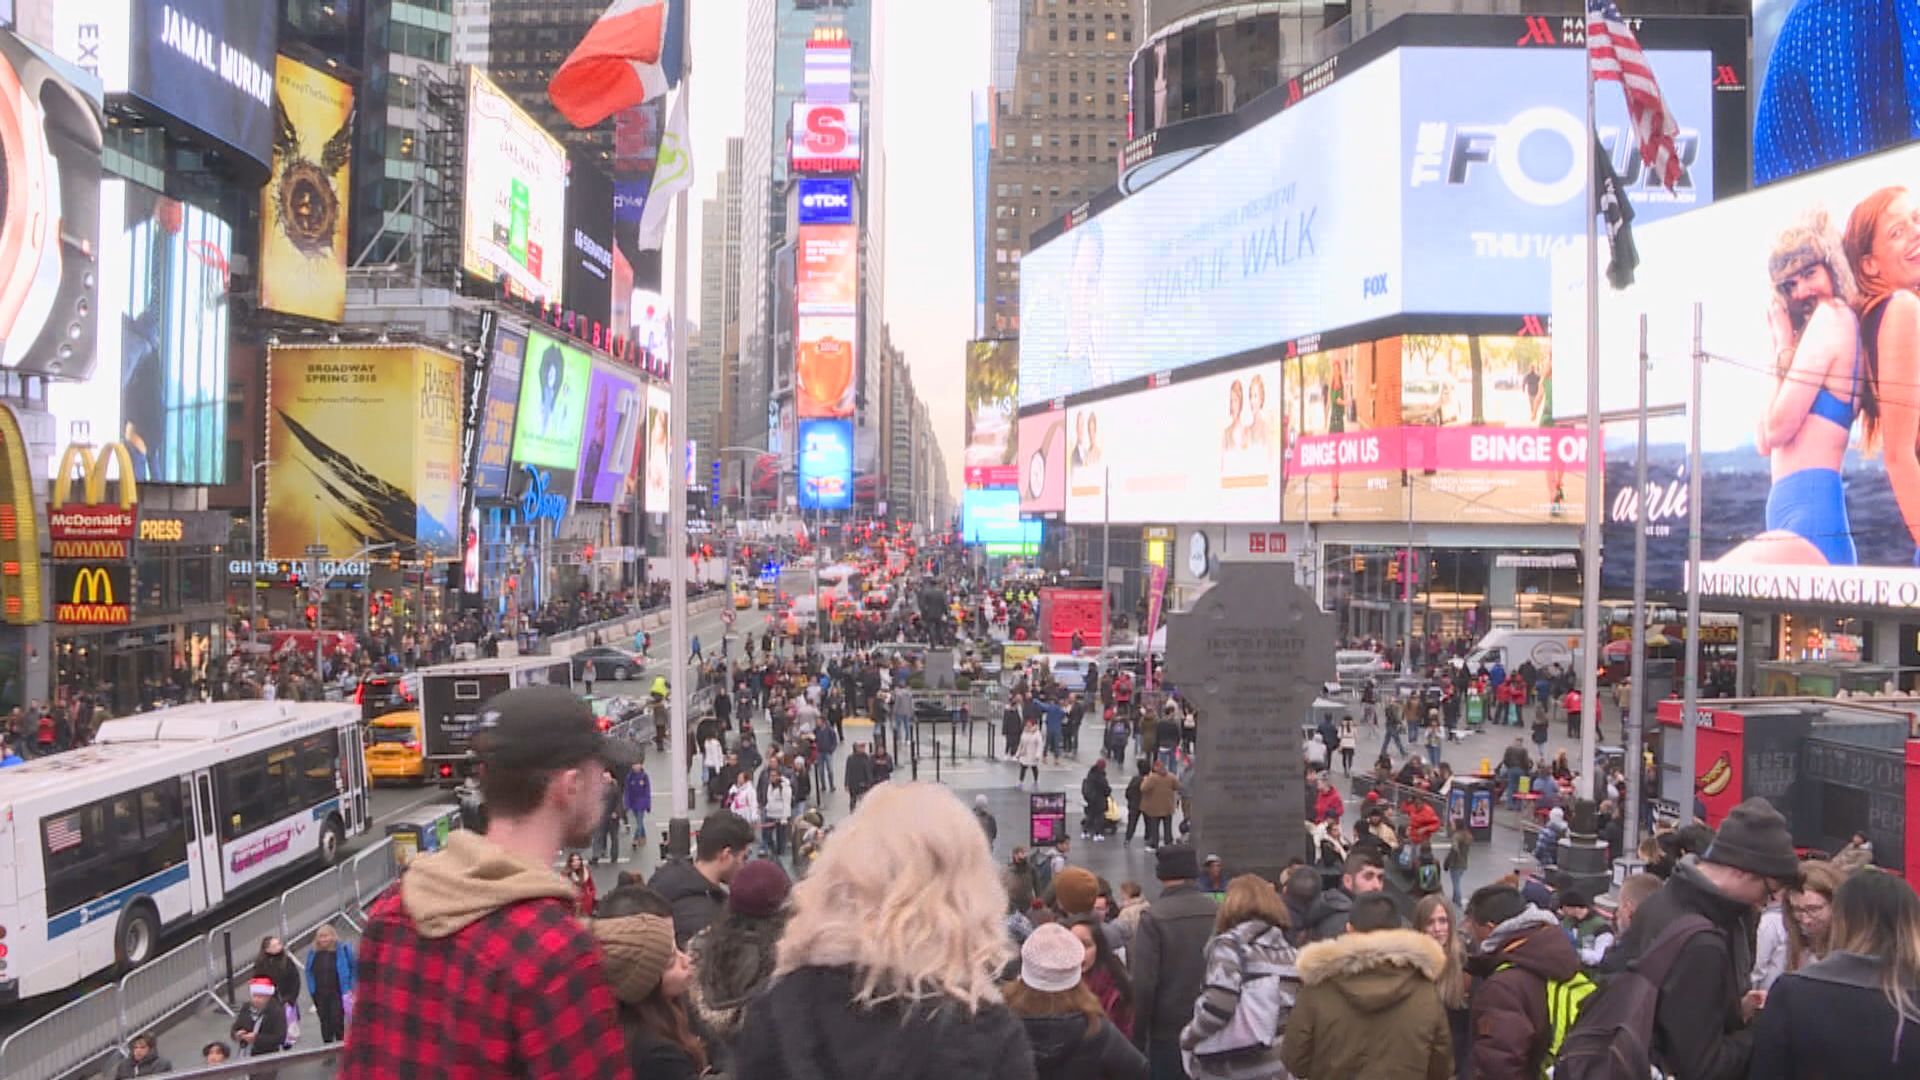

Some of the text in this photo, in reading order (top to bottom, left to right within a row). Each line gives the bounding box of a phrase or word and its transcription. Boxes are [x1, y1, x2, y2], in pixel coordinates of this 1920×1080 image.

[161, 6, 273, 109] JAMAL MURRAY
[815, 193, 848, 208] TDK
[1242, 206, 1317, 279] WALK
[1471, 232, 1529, 257] THU
[1363, 273, 1388, 300] FOX
[305, 374, 377, 383] SPRING 2018
[307, 363, 376, 373] BROADWAY
[423, 361, 455, 394] HARRY
[420, 386, 458, 424] POTTER
[1301, 437, 1379, 467] BINGE ON US
[1470, 435, 1551, 463] BINGE
[522, 464, 568, 539] Disney
[51, 513, 132, 526] McDonald's
[140, 519, 184, 541] PRESS
[1700, 572, 1800, 600] MERICAN
[1810, 575, 1888, 606] EAGLE
